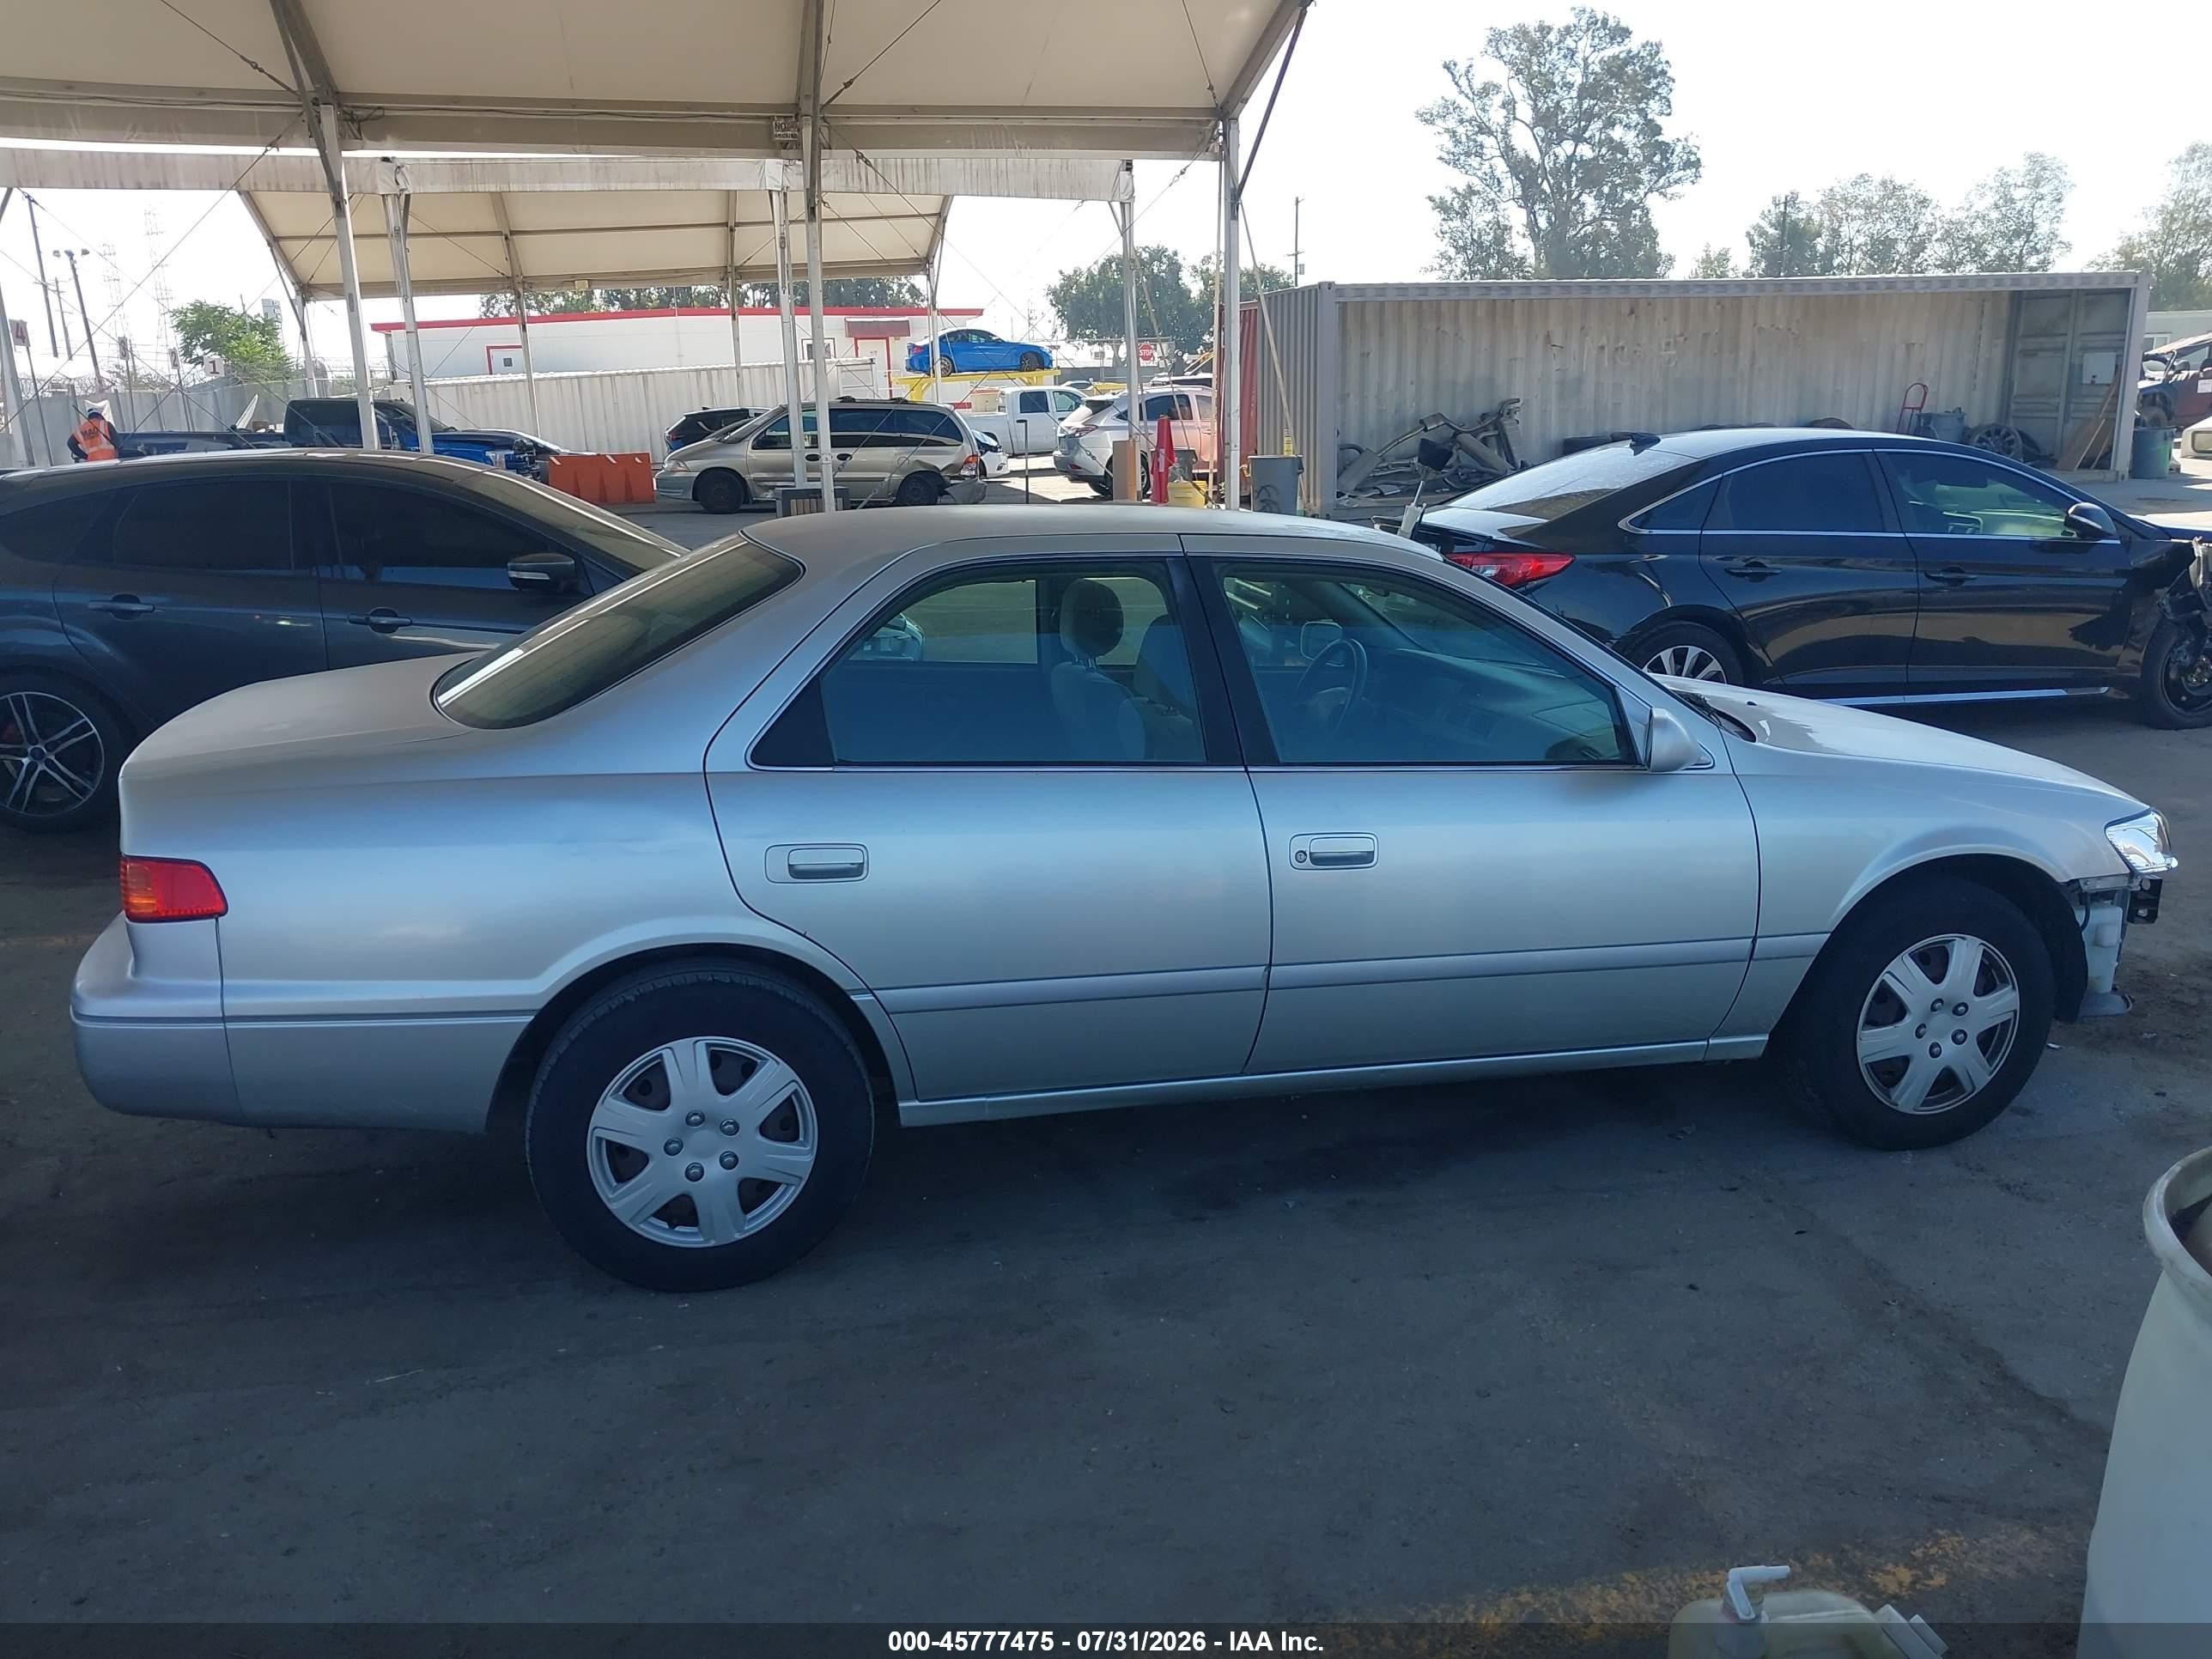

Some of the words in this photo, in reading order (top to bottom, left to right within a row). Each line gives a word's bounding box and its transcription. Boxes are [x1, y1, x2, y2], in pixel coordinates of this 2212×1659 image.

[15, 323, 26, 343] 4
[171, 350, 179, 368] 2
[209, 360, 220, 374] 1
